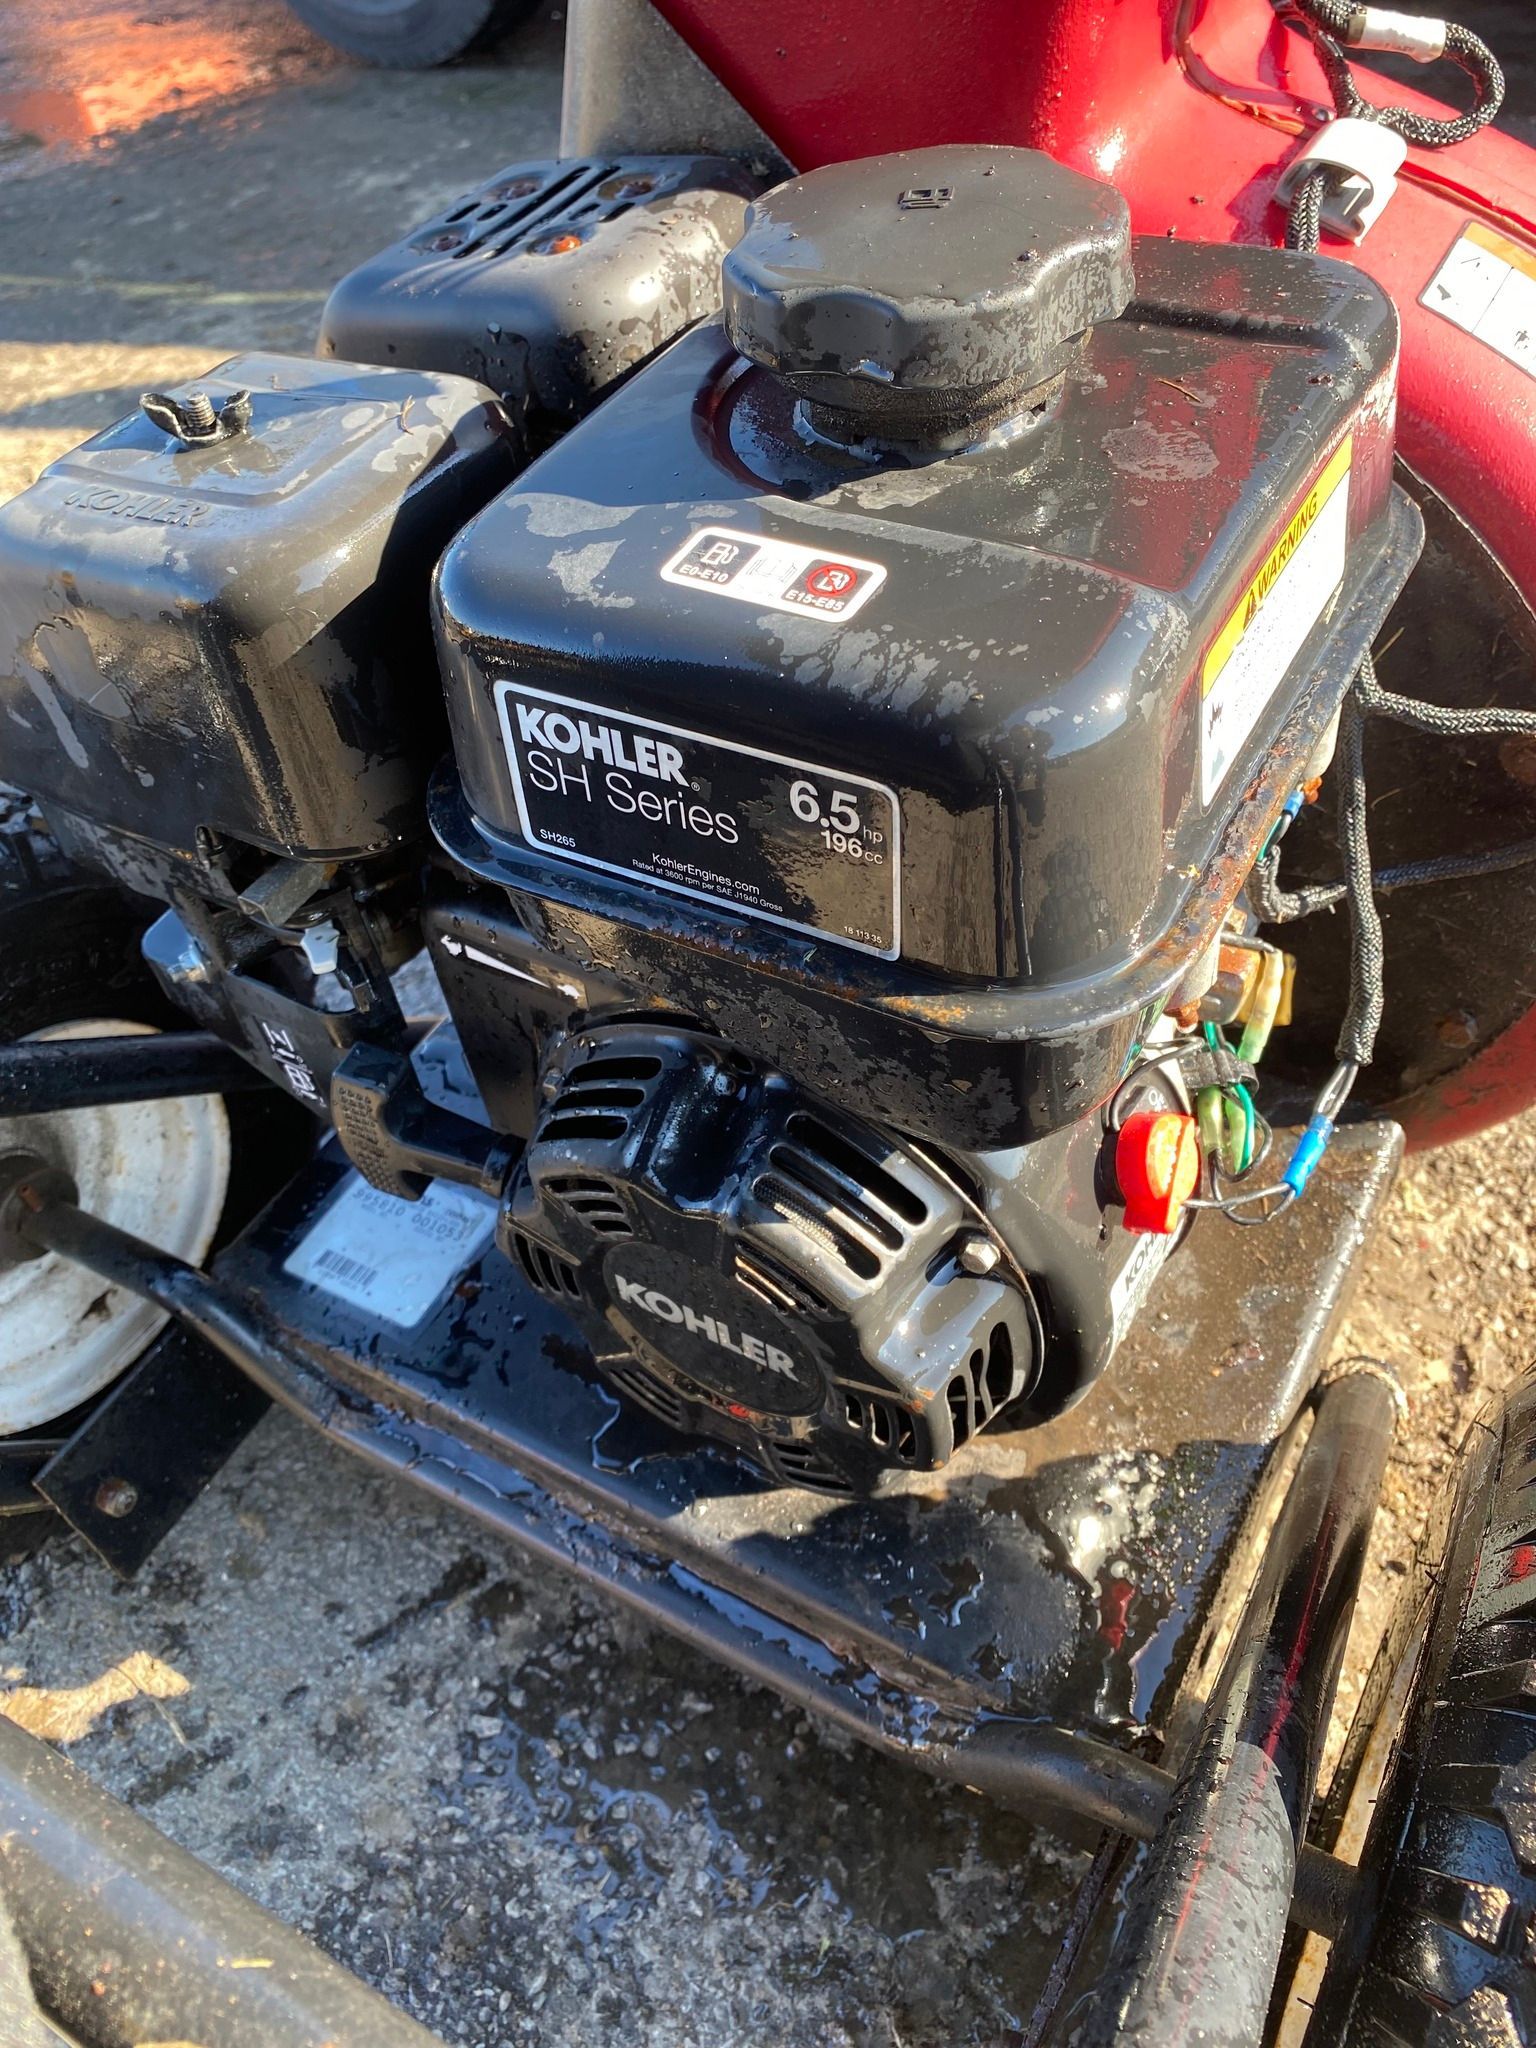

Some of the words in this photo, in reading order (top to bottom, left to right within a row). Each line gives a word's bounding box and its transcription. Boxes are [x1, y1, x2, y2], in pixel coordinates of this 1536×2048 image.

[64, 485, 210, 528] KOHLER
[678, 563, 730, 584] E0-E10
[1257, 492, 1318, 602] WARNING
[785, 588, 845, 612] E15-E85
[515, 703, 689, 787] KOHLER
[527, 750, 592, 803] SH
[605, 772, 739, 845] Series
[789, 780, 860, 835] 6.5
[863, 825, 883, 843] hp
[539, 828, 577, 849] SH265
[821, 830, 863, 858] 196
[864, 851, 883, 865] cc
[632, 858, 654, 872] Rated
[656, 865, 664, 875] at
[664, 866, 684, 882] 3600
[685, 876, 701, 888] rpm
[702, 880, 715, 892] per
[716, 883, 733, 897] SAE
[734, 888, 758, 904] J1940
[759, 895, 783, 913] Gross
[652, 853, 760, 896] KohlerEngines.com
[1124, 1233, 1156, 1291] KOH
[615, 1274, 799, 1382] KOHLER
